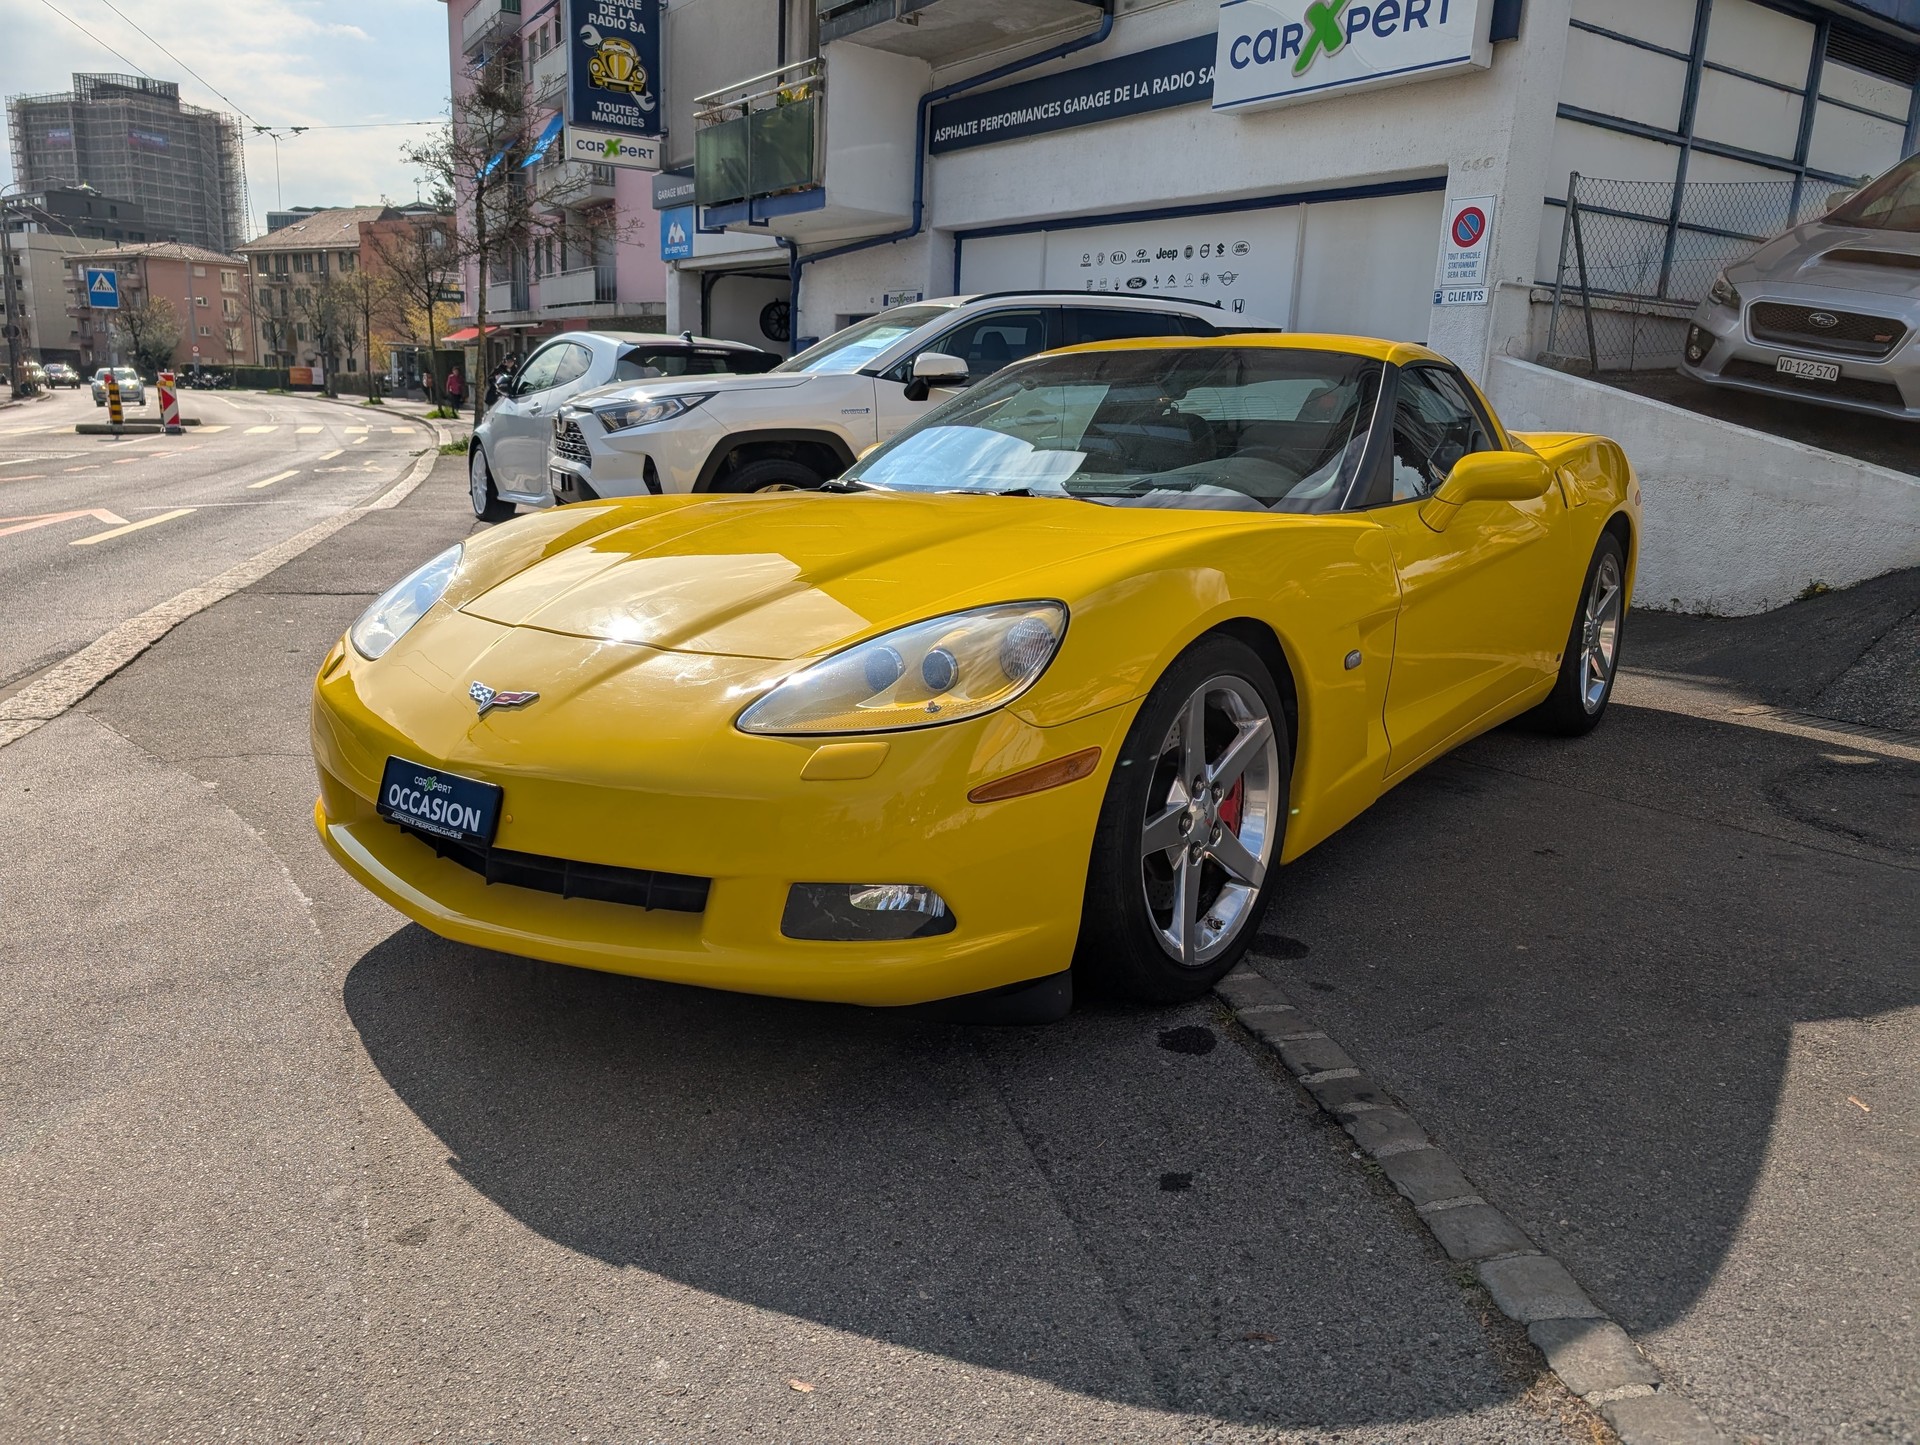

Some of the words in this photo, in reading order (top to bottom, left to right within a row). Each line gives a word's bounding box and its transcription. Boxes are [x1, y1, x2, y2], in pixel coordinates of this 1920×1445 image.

[600, 4, 616, 16] DE
[619, 8, 635, 20] LA
[588, 13, 627, 30] RADIO
[630, 21, 646, 34] SA
[597, 101, 640, 116] TOUTES
[934, 120, 978, 142] ASPHALTE
[980, 101, 1061, 132] PERFORMANCES
[1063, 91, 1111, 114] GARAGE
[1114, 86, 1130, 103] DE
[1133, 83, 1149, 98] LA
[1152, 70, 1195, 95] RADIO
[1198, 66, 1215, 84] SA
[591, 111, 645, 128] MARQUES
[657, 188, 676, 200] GARAGE
[1113, 253, 1124, 262] KIA
[1156, 247, 1178, 261] Jeep
[1448, 261, 1478, 269] STATIONNANT
[1448, 290, 1484, 302] CLIENTS
[388, 783, 481, 832] OCCASION
